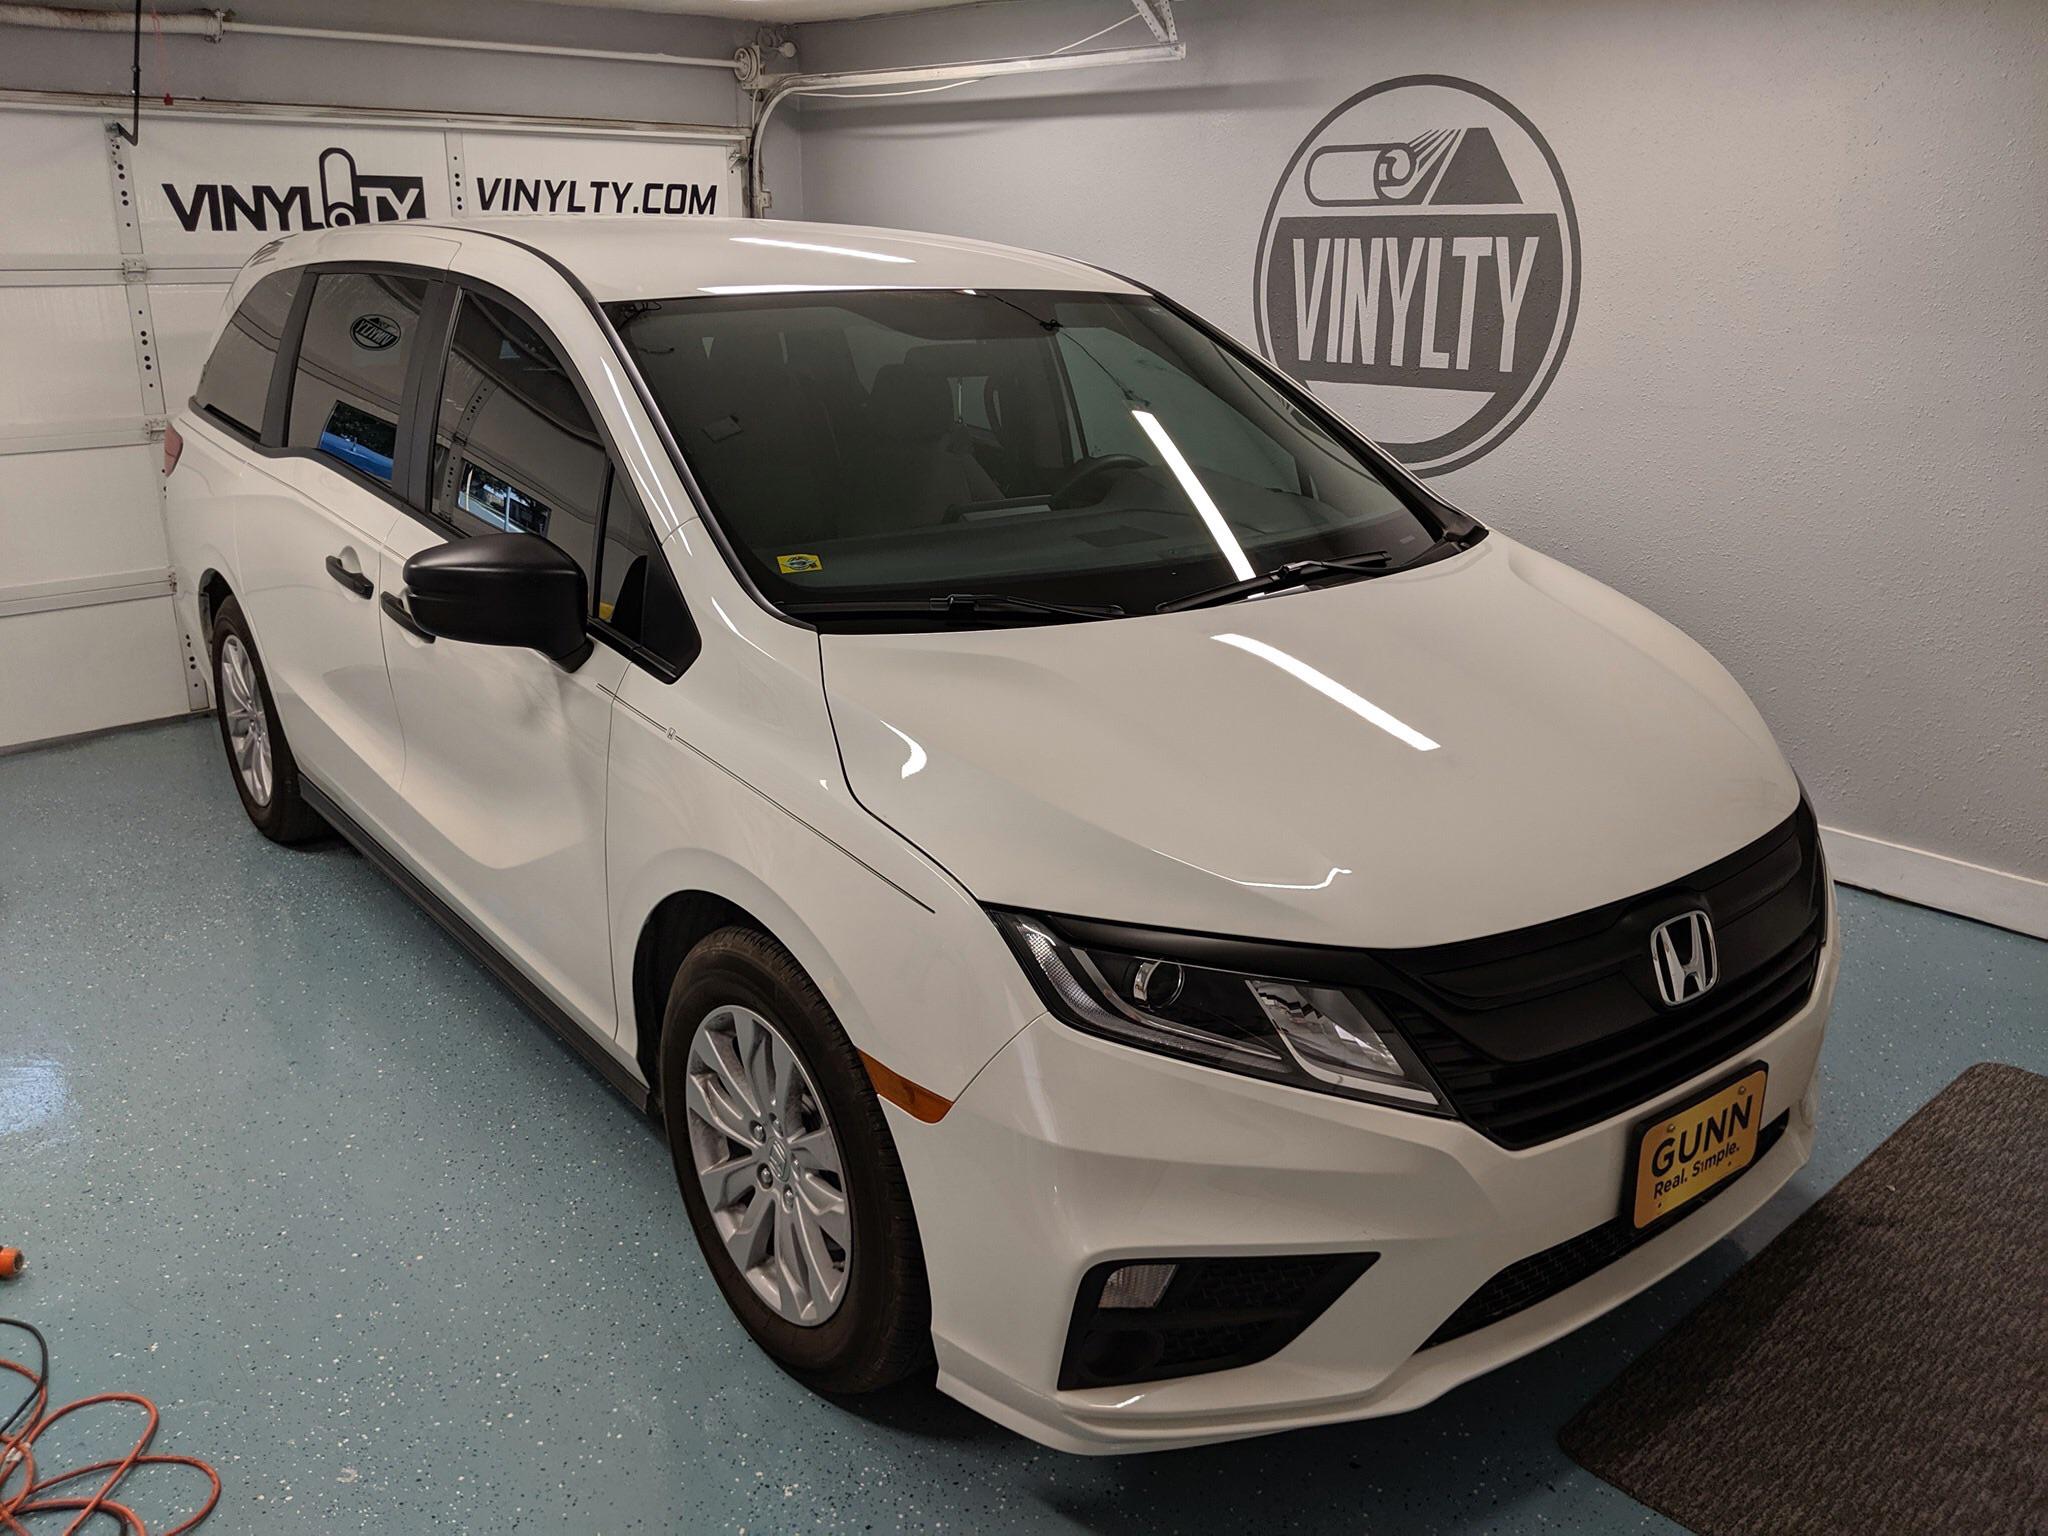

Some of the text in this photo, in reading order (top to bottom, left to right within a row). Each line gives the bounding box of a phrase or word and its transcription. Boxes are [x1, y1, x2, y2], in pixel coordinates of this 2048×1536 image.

[476, 177, 718, 215] VINYLTY.COM
[1293, 236, 1539, 372] VINYLTY
[1651, 1095, 1753, 1178] GUNN
[1653, 1141, 1740, 1200] Real. Simple.
